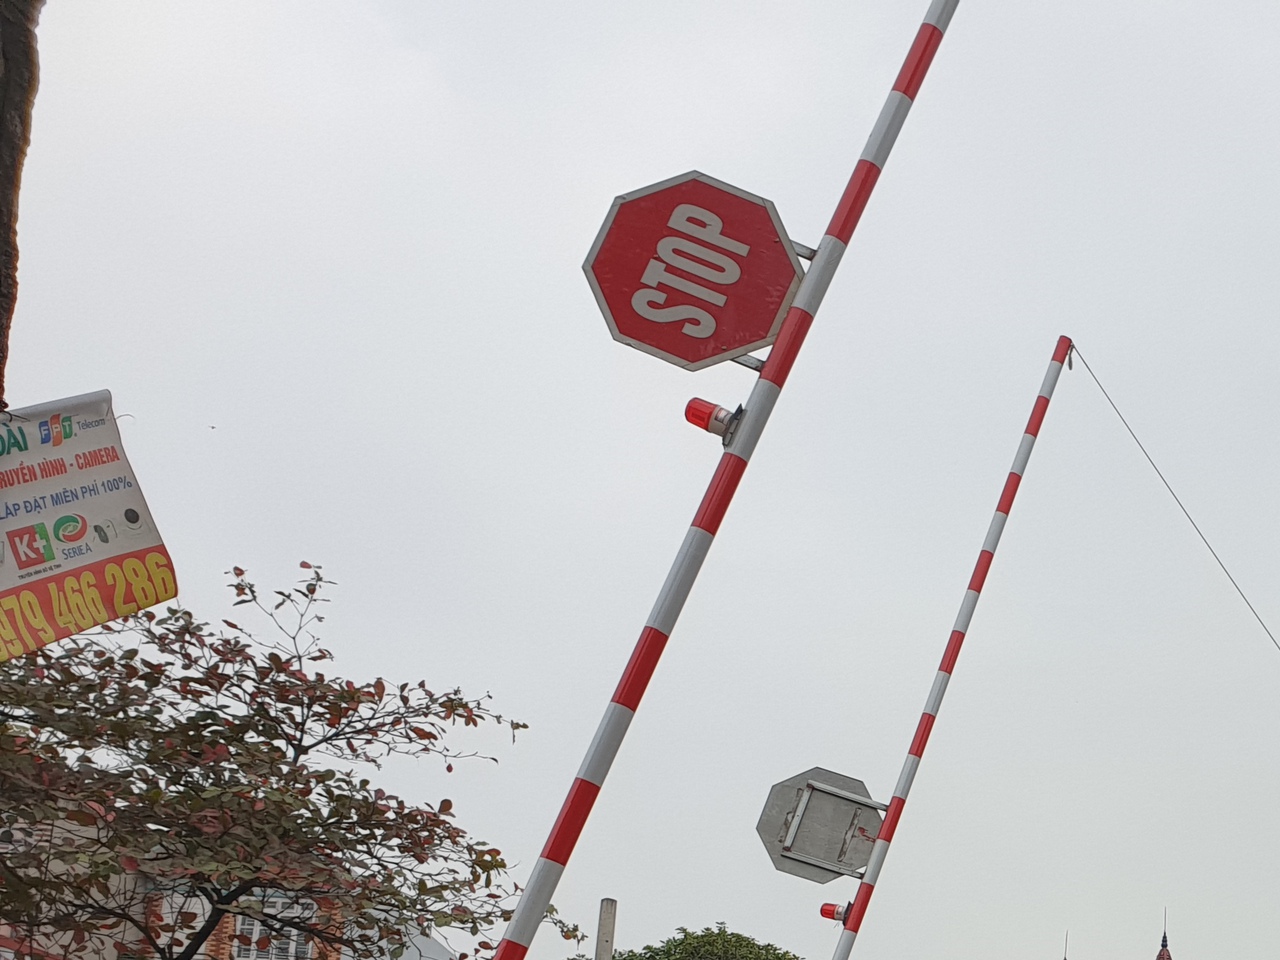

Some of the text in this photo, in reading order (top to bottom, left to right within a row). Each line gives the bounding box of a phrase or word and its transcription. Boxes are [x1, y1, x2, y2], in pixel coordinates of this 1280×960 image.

[631, 203, 751, 339] STOP
[39, 413, 73, 447] FPT
[76, 419, 106, 431] Telecom
[38, 457, 68, 480] HÌNH
[75, 446, 120, 470] CAMERA
[80, 479, 100, 499] PHÍ
[101, 476, 133, 495] 100%
[0, 551, 176, 662] 979 466 286
